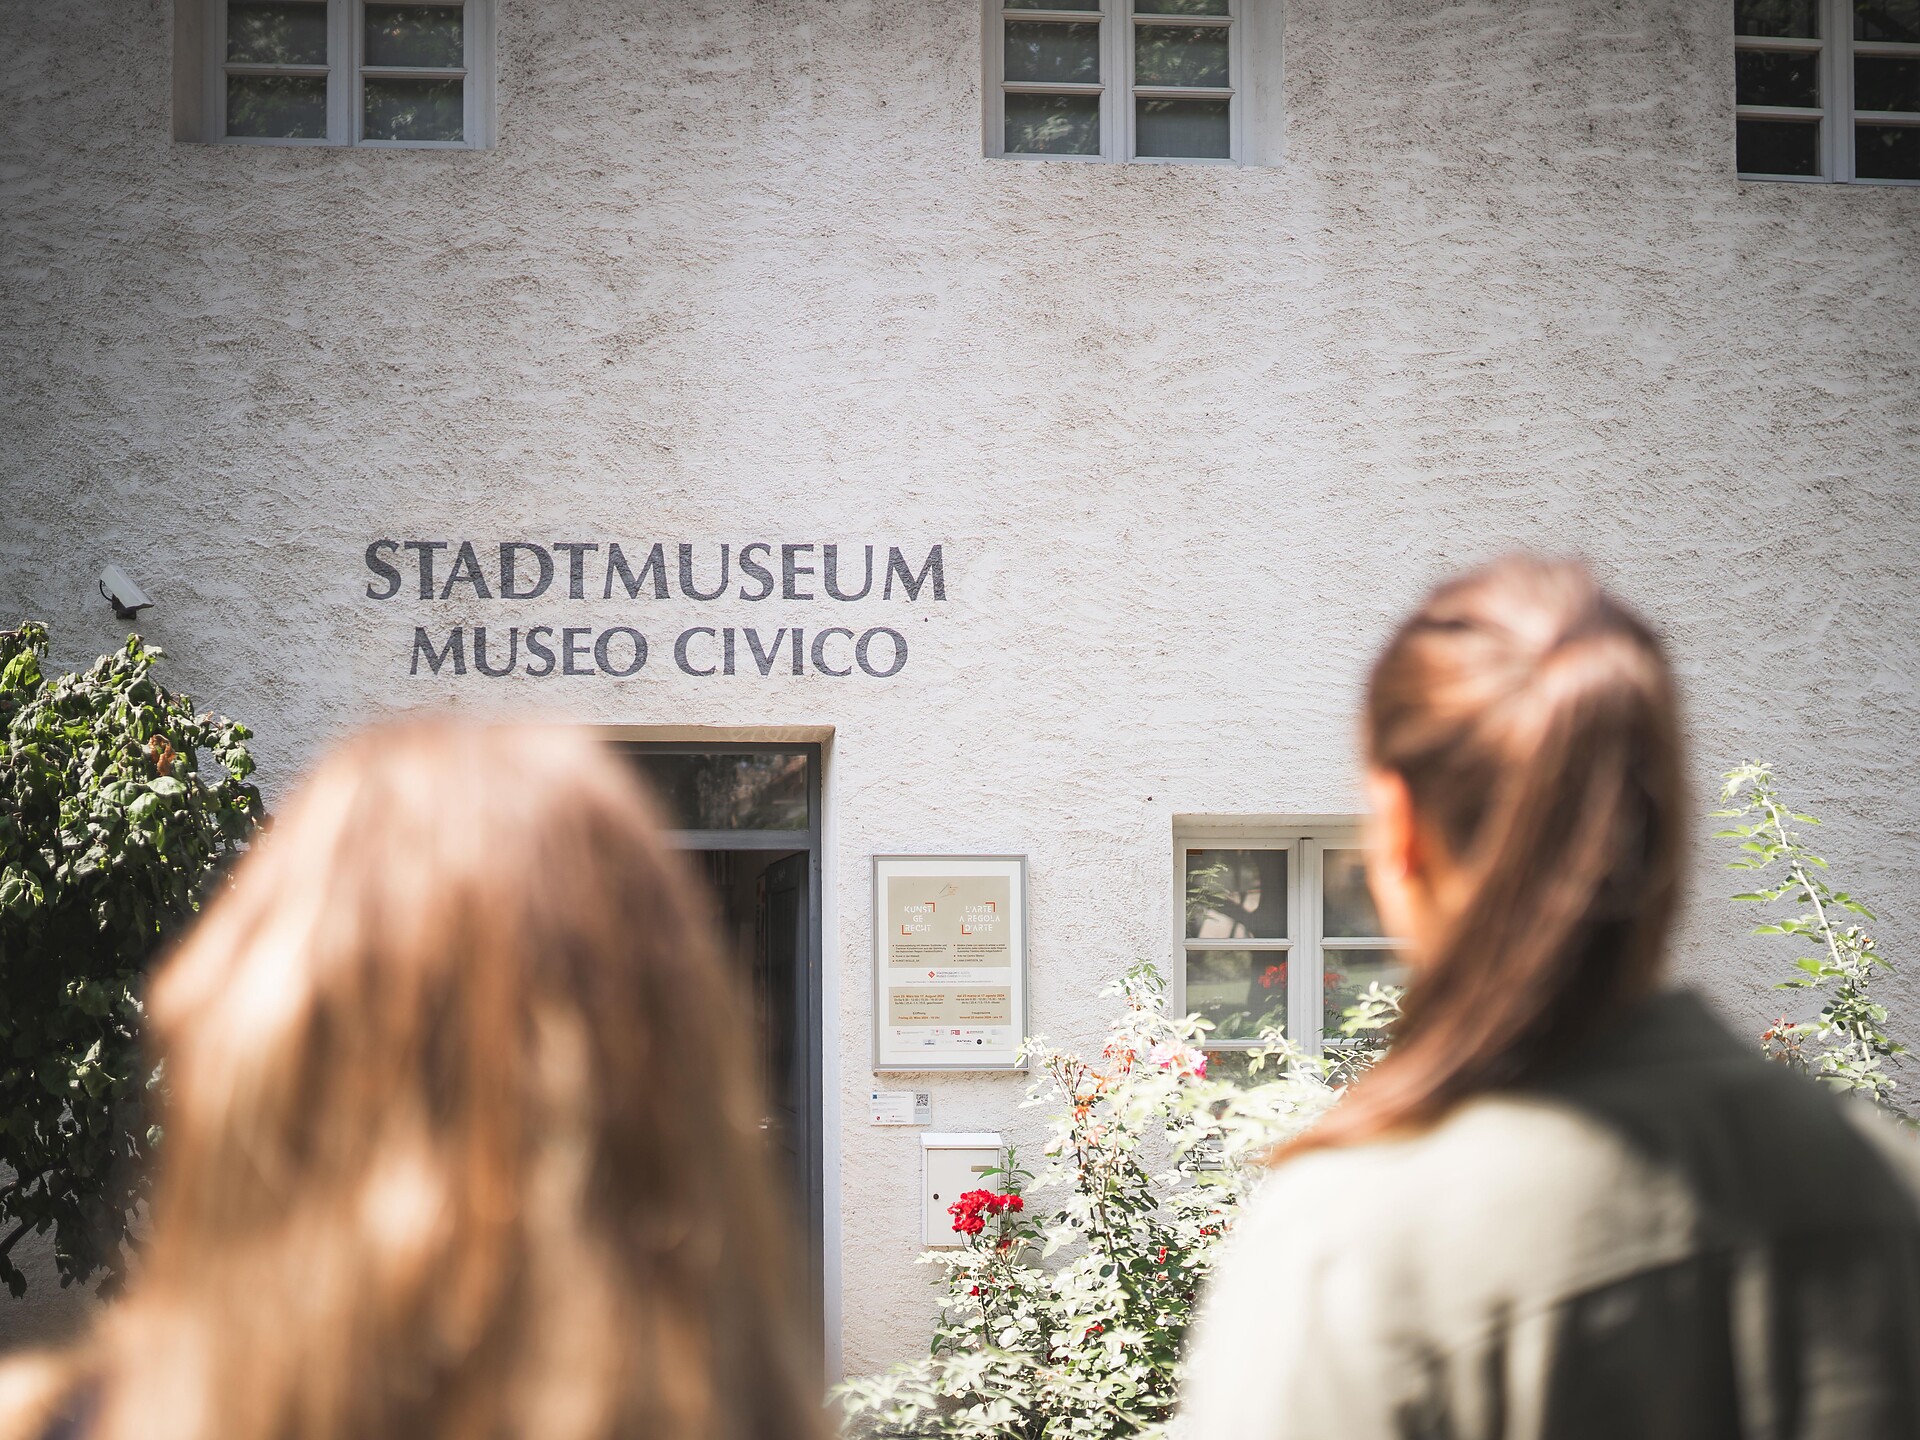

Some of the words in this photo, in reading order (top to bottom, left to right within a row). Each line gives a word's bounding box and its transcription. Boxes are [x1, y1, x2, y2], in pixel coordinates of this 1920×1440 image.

[365, 539, 947, 602] STADTMUSEUM
[410, 625, 648, 677] MUSEO
[673, 625, 909, 678] CIVICO
[904, 905, 932, 913] KUNST
[905, 924, 932, 932] RECHT
